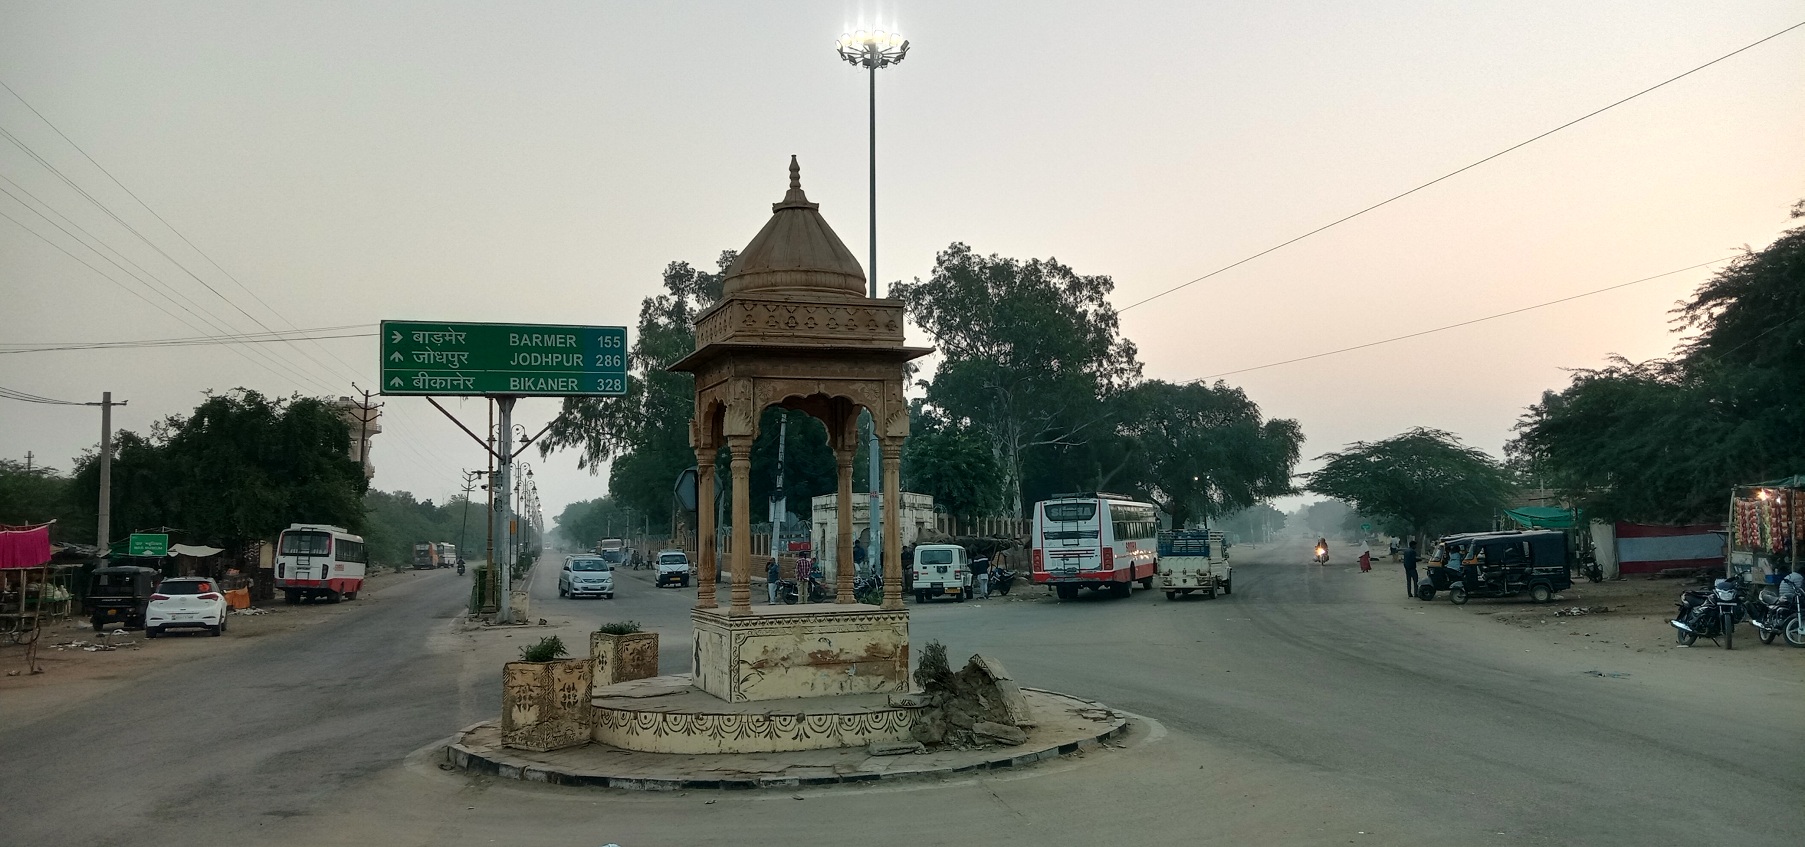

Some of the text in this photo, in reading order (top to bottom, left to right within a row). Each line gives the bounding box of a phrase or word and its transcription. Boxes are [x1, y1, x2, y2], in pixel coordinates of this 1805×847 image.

[412, 327, 466, 346] बाड़मेर
[510, 333, 621, 348] BARMER 155
[412, 347, 469, 368] जोधपुर
[510, 353, 621, 367] JODHPUR 286
[412, 372, 475, 389] बीकानेर
[510, 378, 621, 391] BIKANER 328
